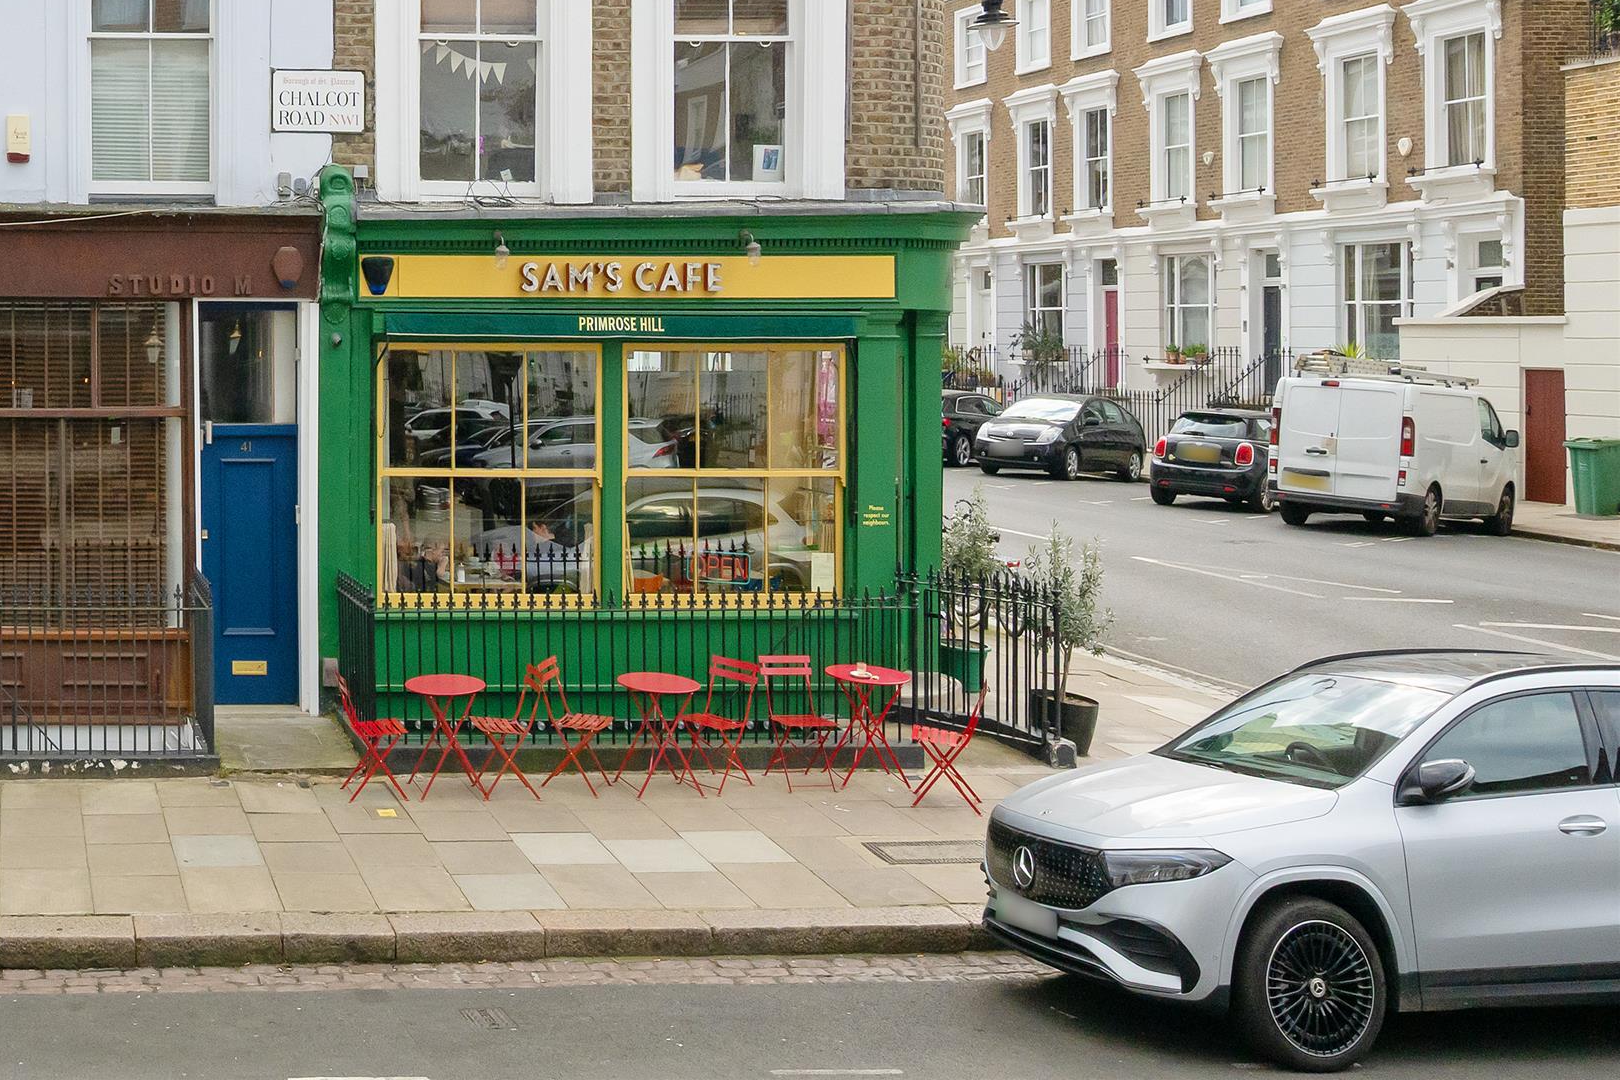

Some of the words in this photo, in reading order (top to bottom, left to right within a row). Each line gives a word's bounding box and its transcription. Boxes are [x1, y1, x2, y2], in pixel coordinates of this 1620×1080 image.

[279, 90, 360, 107] CHALCOT
[279, 110, 325, 126] ROAD
[329, 114, 359, 126] NW1
[109, 273, 215, 295] STUDIO
[234, 275, 253, 295] M
[520, 262, 623, 293] SAM'S
[632, 262, 724, 293] CAFE
[578, 316, 637, 332] PRIMROSE
[640, 317, 665, 332] HILL
[240, 441, 252, 452] 41
[690, 554, 748, 580] OPEN
